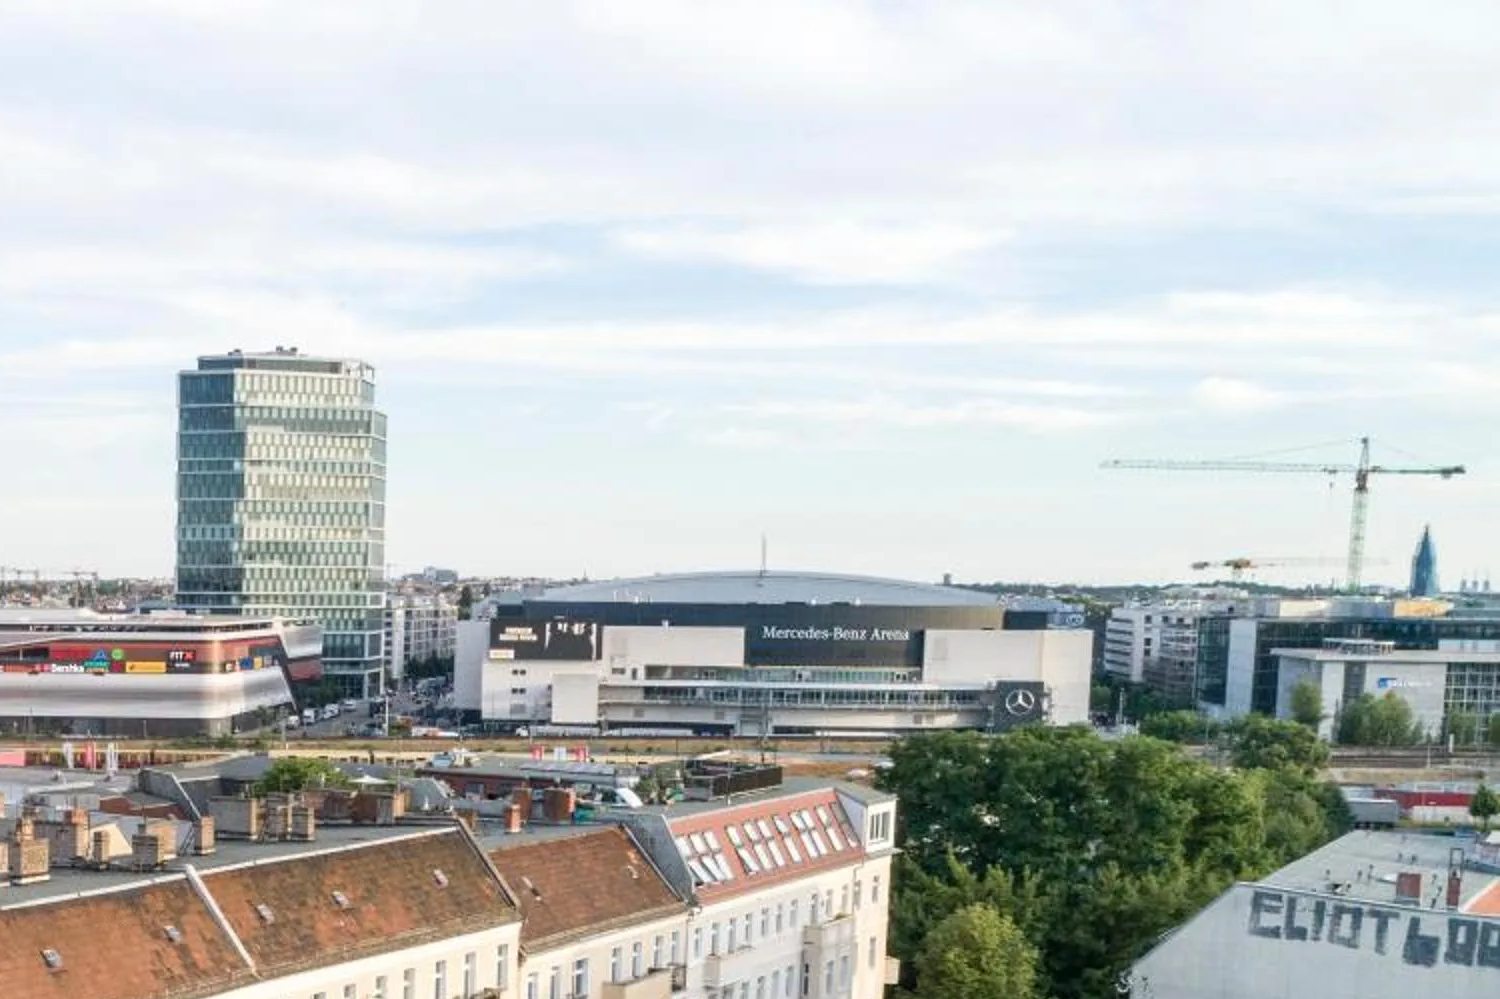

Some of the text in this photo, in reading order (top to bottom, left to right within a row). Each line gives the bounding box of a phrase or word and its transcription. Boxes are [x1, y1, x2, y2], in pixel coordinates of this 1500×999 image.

[762, 625, 910, 641] Mercedes-Benz Arena
[51, 663, 85, 673] Bershka
